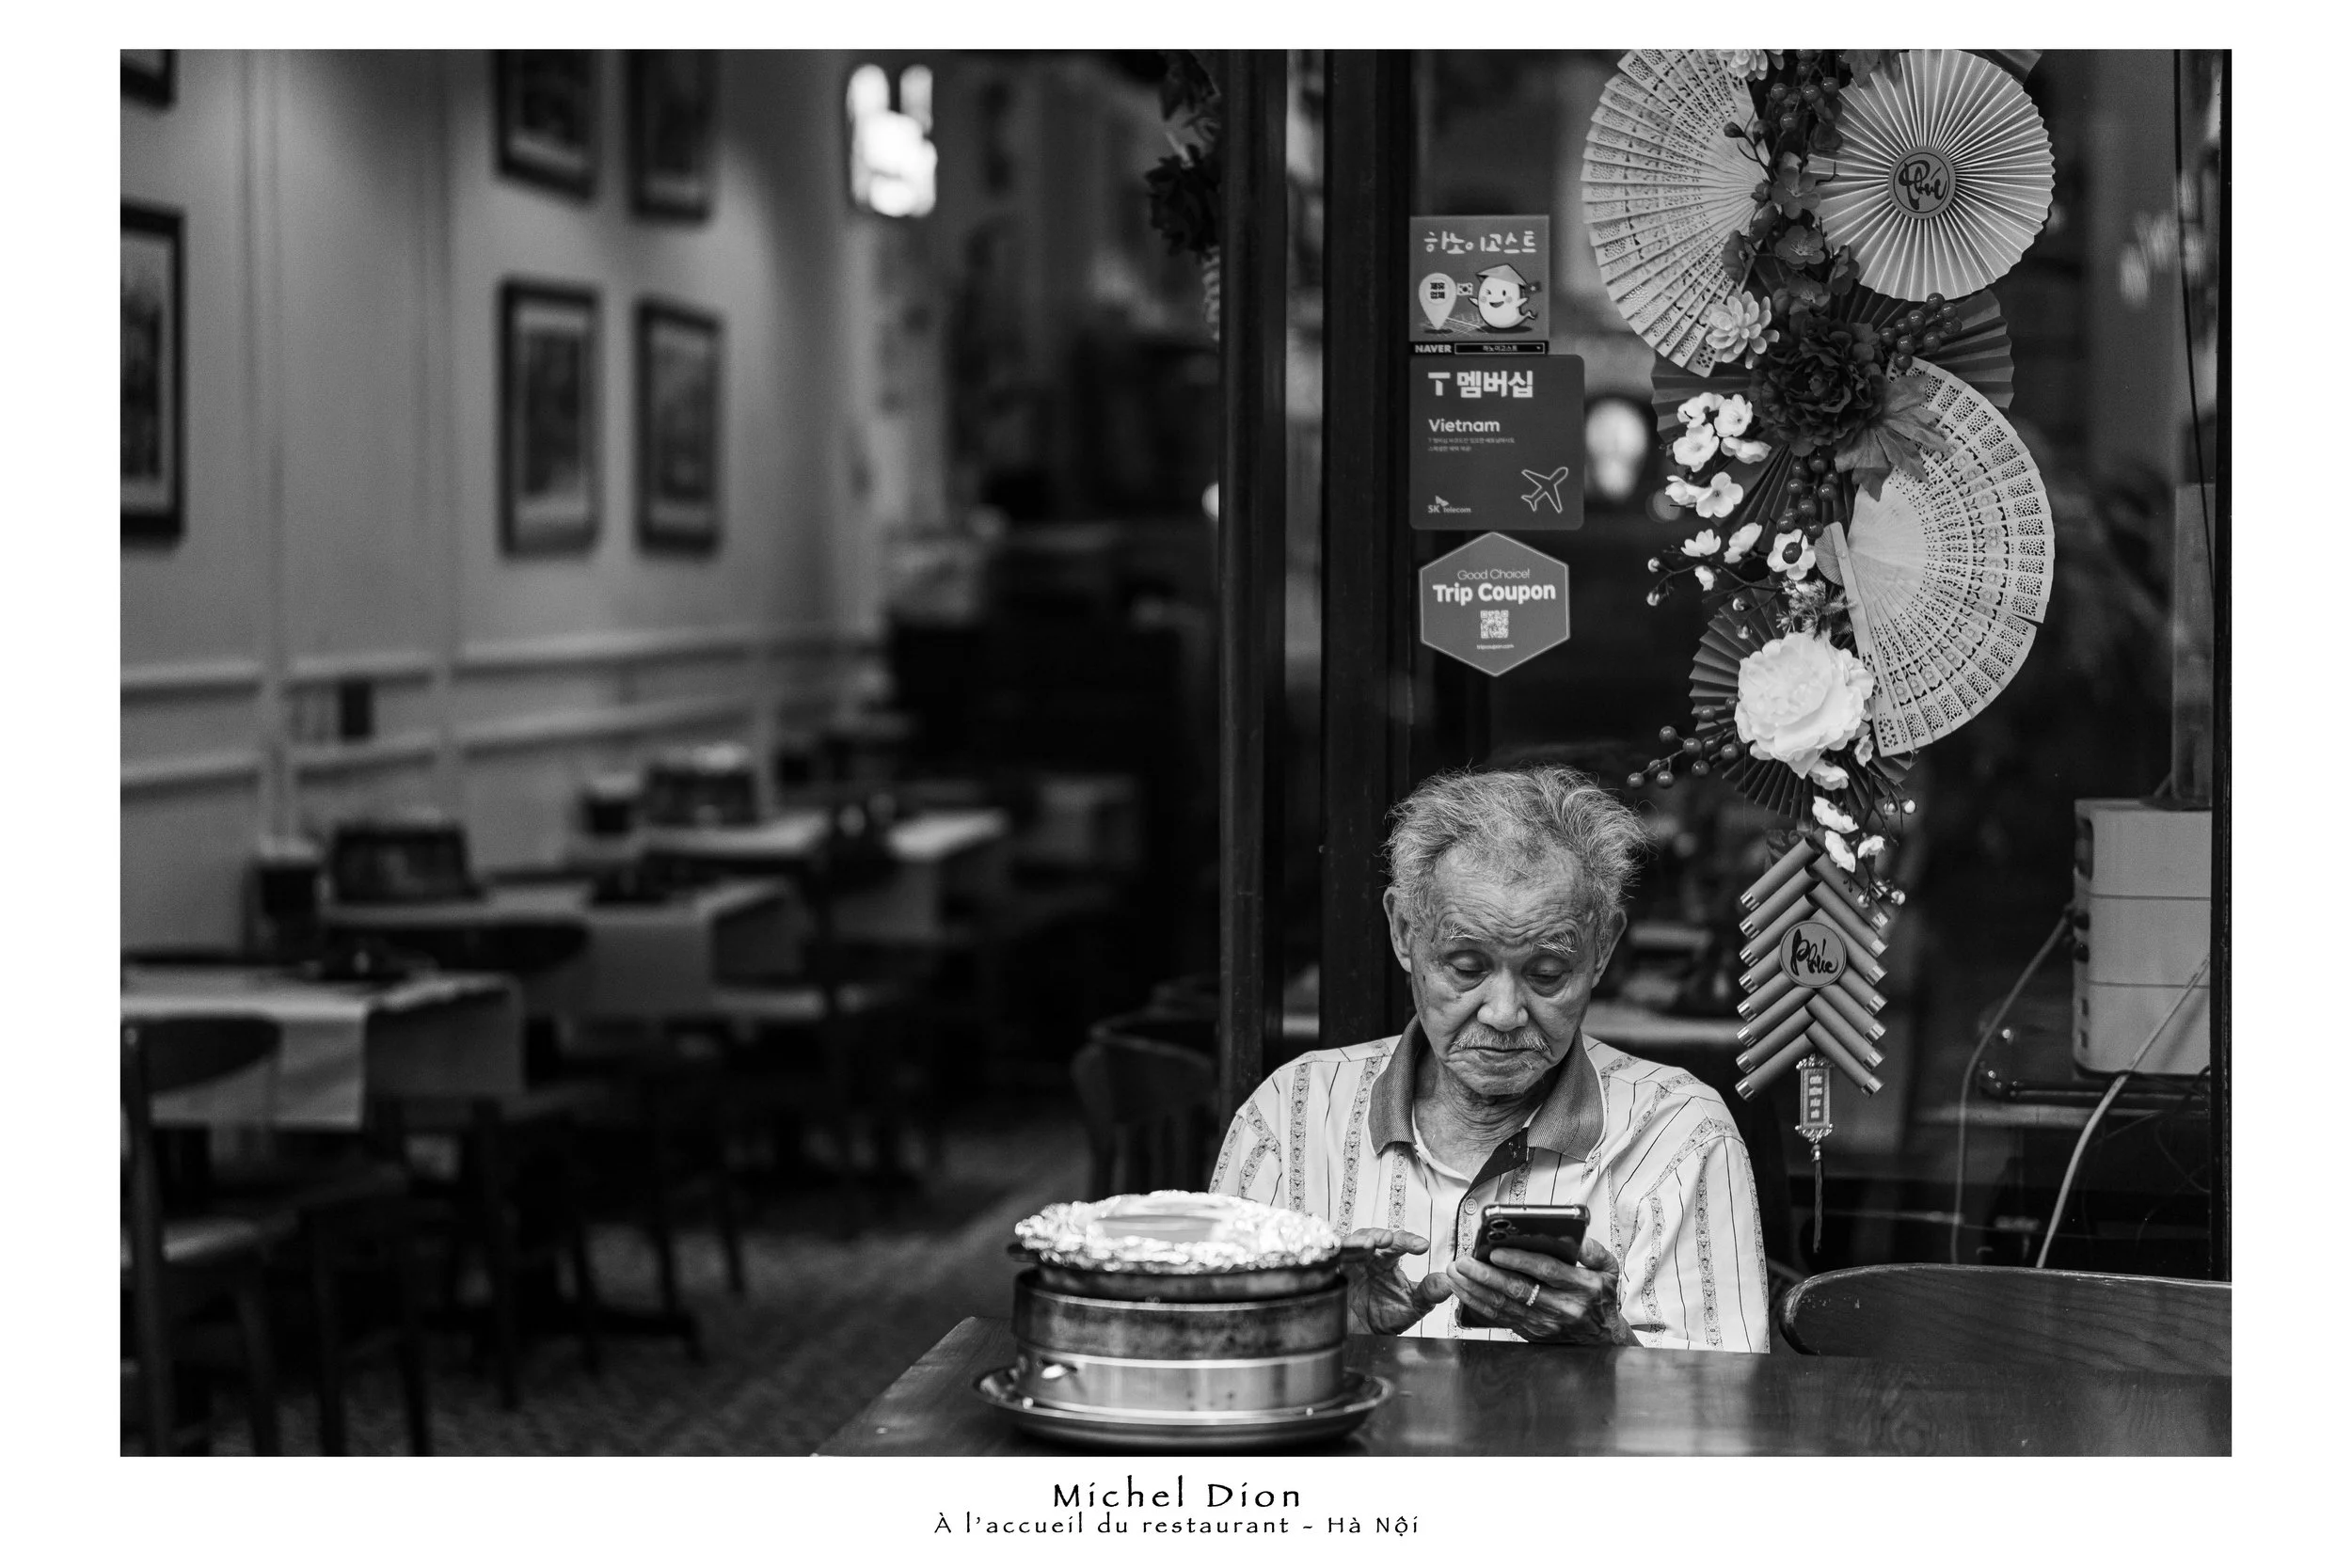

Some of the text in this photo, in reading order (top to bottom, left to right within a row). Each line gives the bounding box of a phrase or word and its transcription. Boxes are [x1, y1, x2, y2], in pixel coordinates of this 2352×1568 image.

[1423, 230, 1537, 255] 하노이고스트
[1415, 344, 1452, 354] NAVER
[1428, 370, 1534, 398] T 멤버십
[1428, 418, 1501, 433] Vietnam
[1427, 505, 1440, 514] SK
[1457, 568, 1531, 580] Good Choice!
[1432, 582, 1556, 607] Trip Coupon
